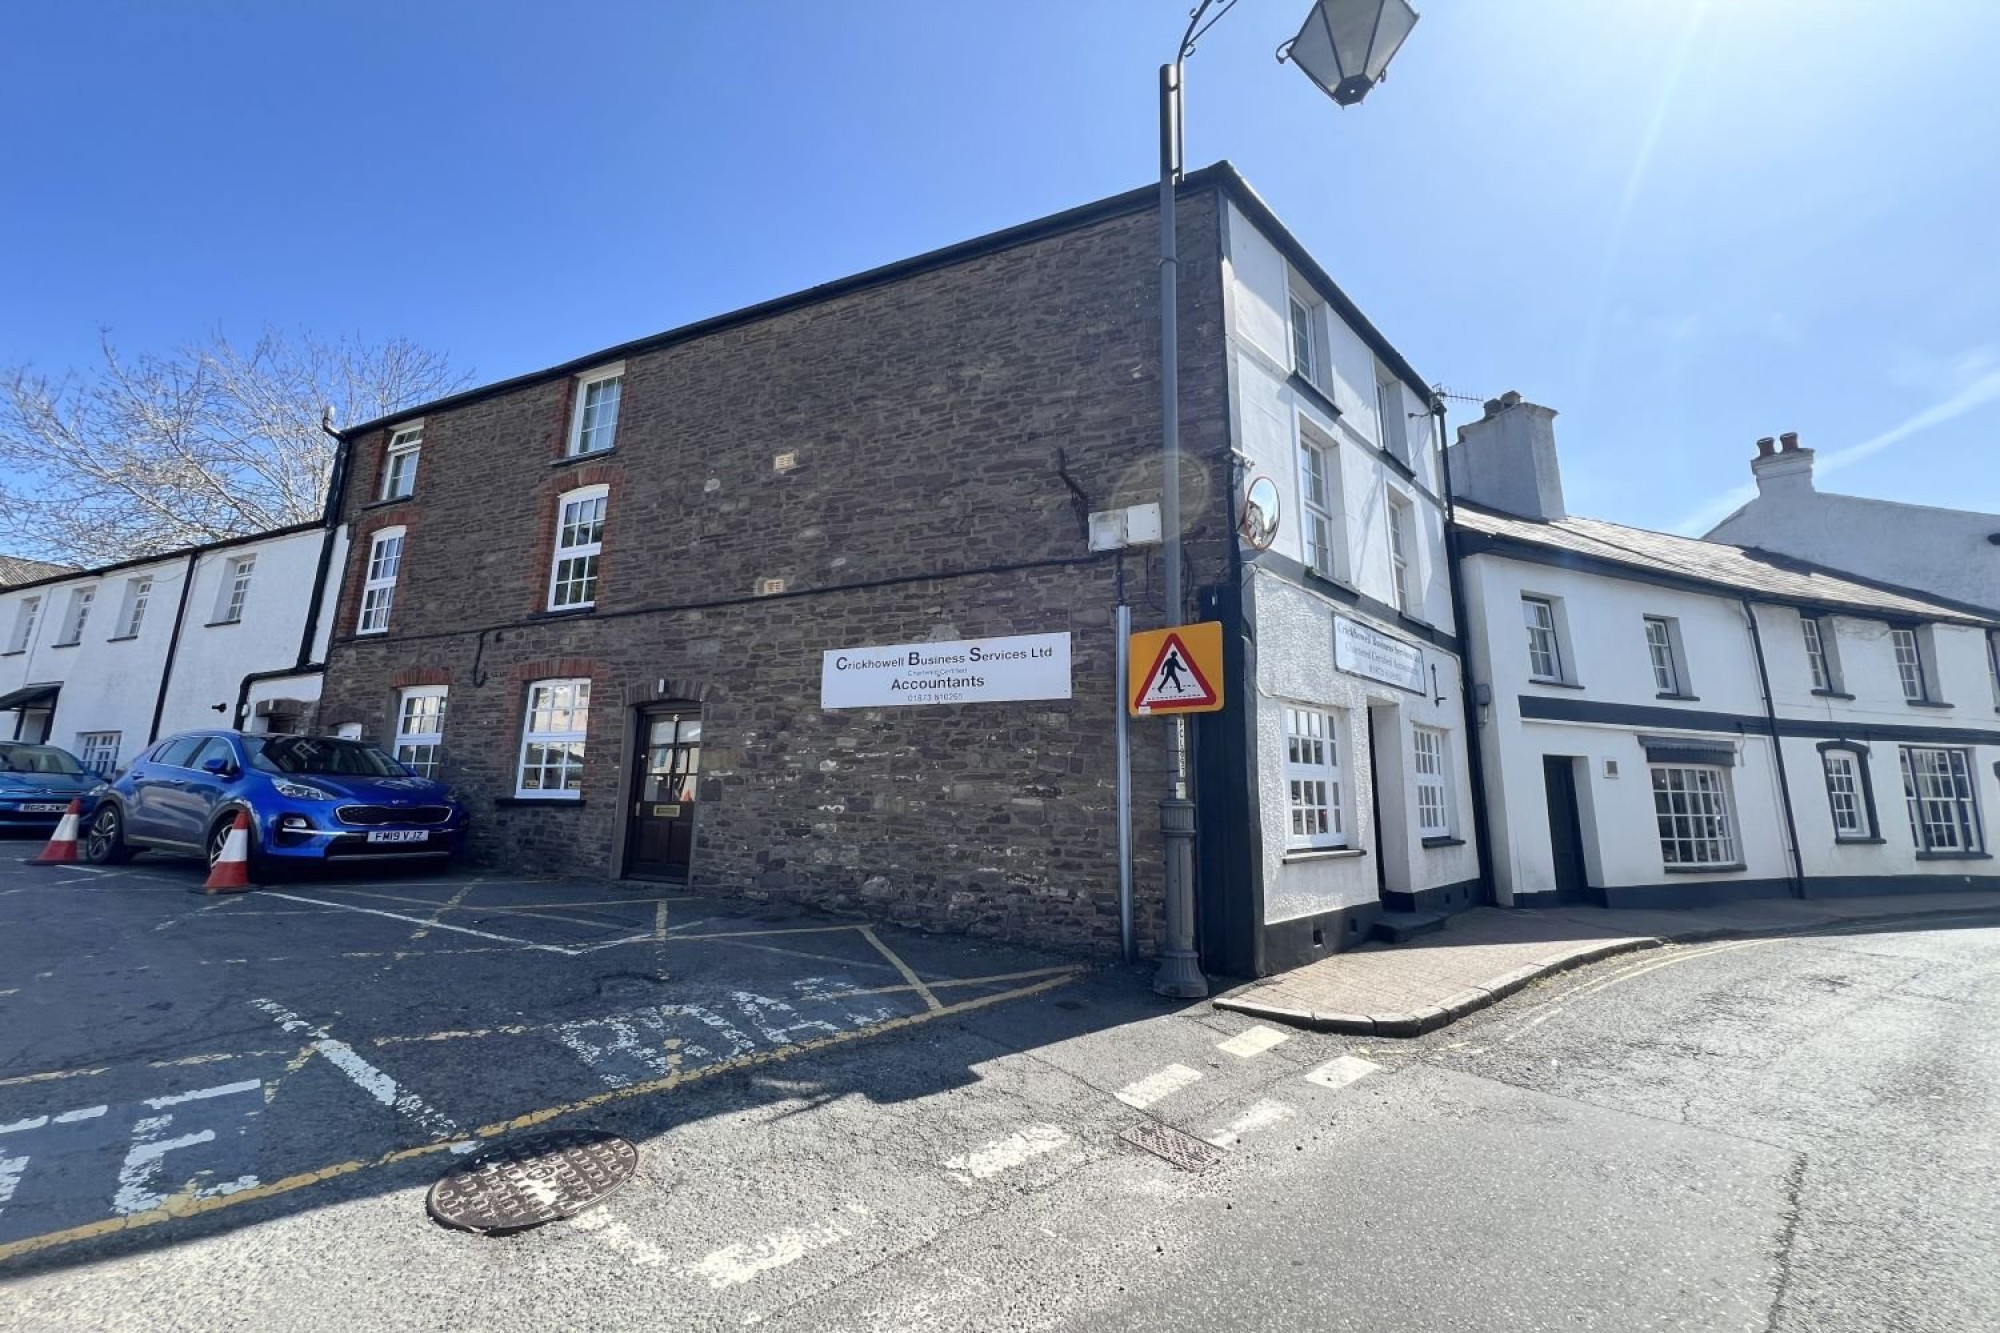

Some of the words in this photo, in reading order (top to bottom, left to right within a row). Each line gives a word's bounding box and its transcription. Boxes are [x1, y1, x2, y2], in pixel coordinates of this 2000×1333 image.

[836, 656, 904, 670] Crickhowell
[908, 651, 965, 666] Business
[969, 647, 1027, 662] Services
[1031, 646, 1052, 658] Ltd
[891, 676, 984, 690] Accountants
[375, 832, 400, 841] FM19
